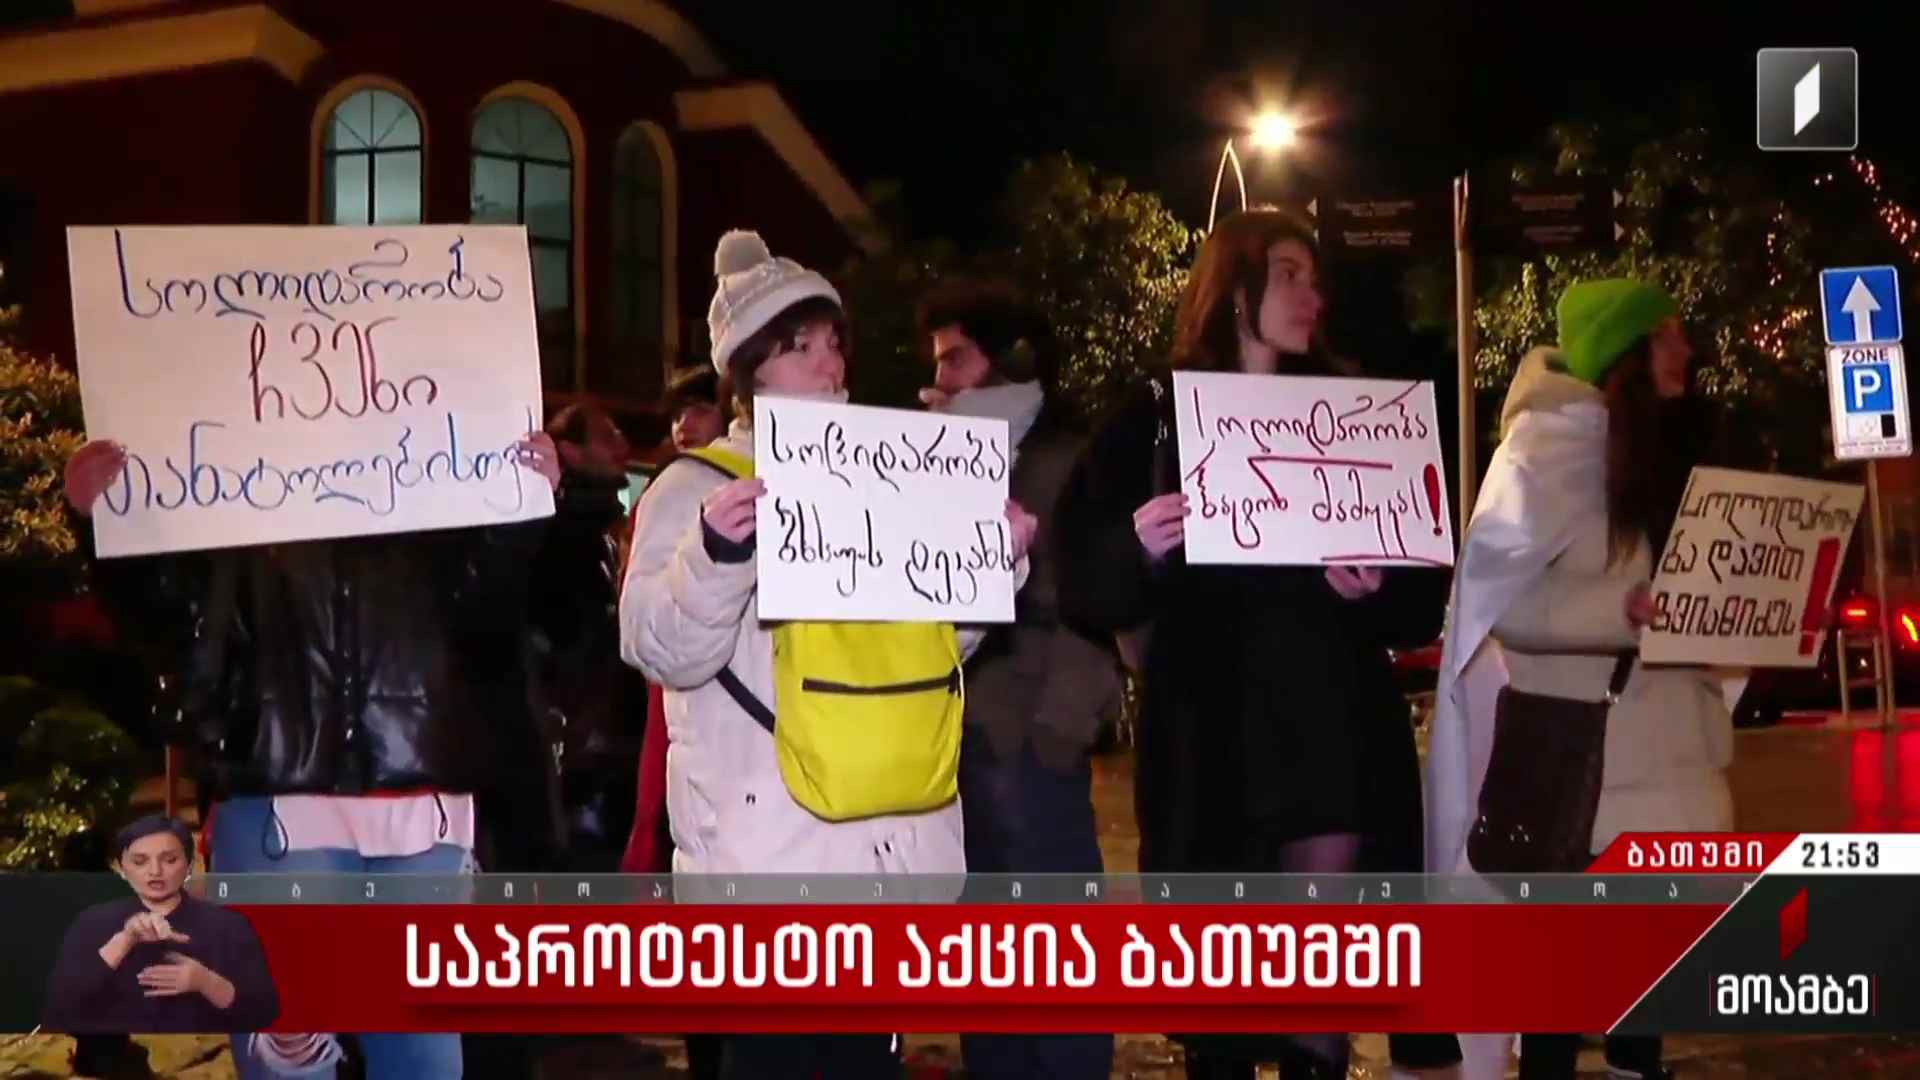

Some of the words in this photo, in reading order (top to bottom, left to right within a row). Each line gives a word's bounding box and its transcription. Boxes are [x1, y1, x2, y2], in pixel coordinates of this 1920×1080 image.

[115, 229, 504, 321] სოლიდარობა
[249, 317, 438, 422] ჩვენი
[1841, 350, 1889, 364] ZONE
[1853, 369, 1881, 409] P
[769, 409, 1006, 493] სოლიდარობა
[1662, 530, 1697, 574] ბა
[1707, 540, 1806, 584] დავით
